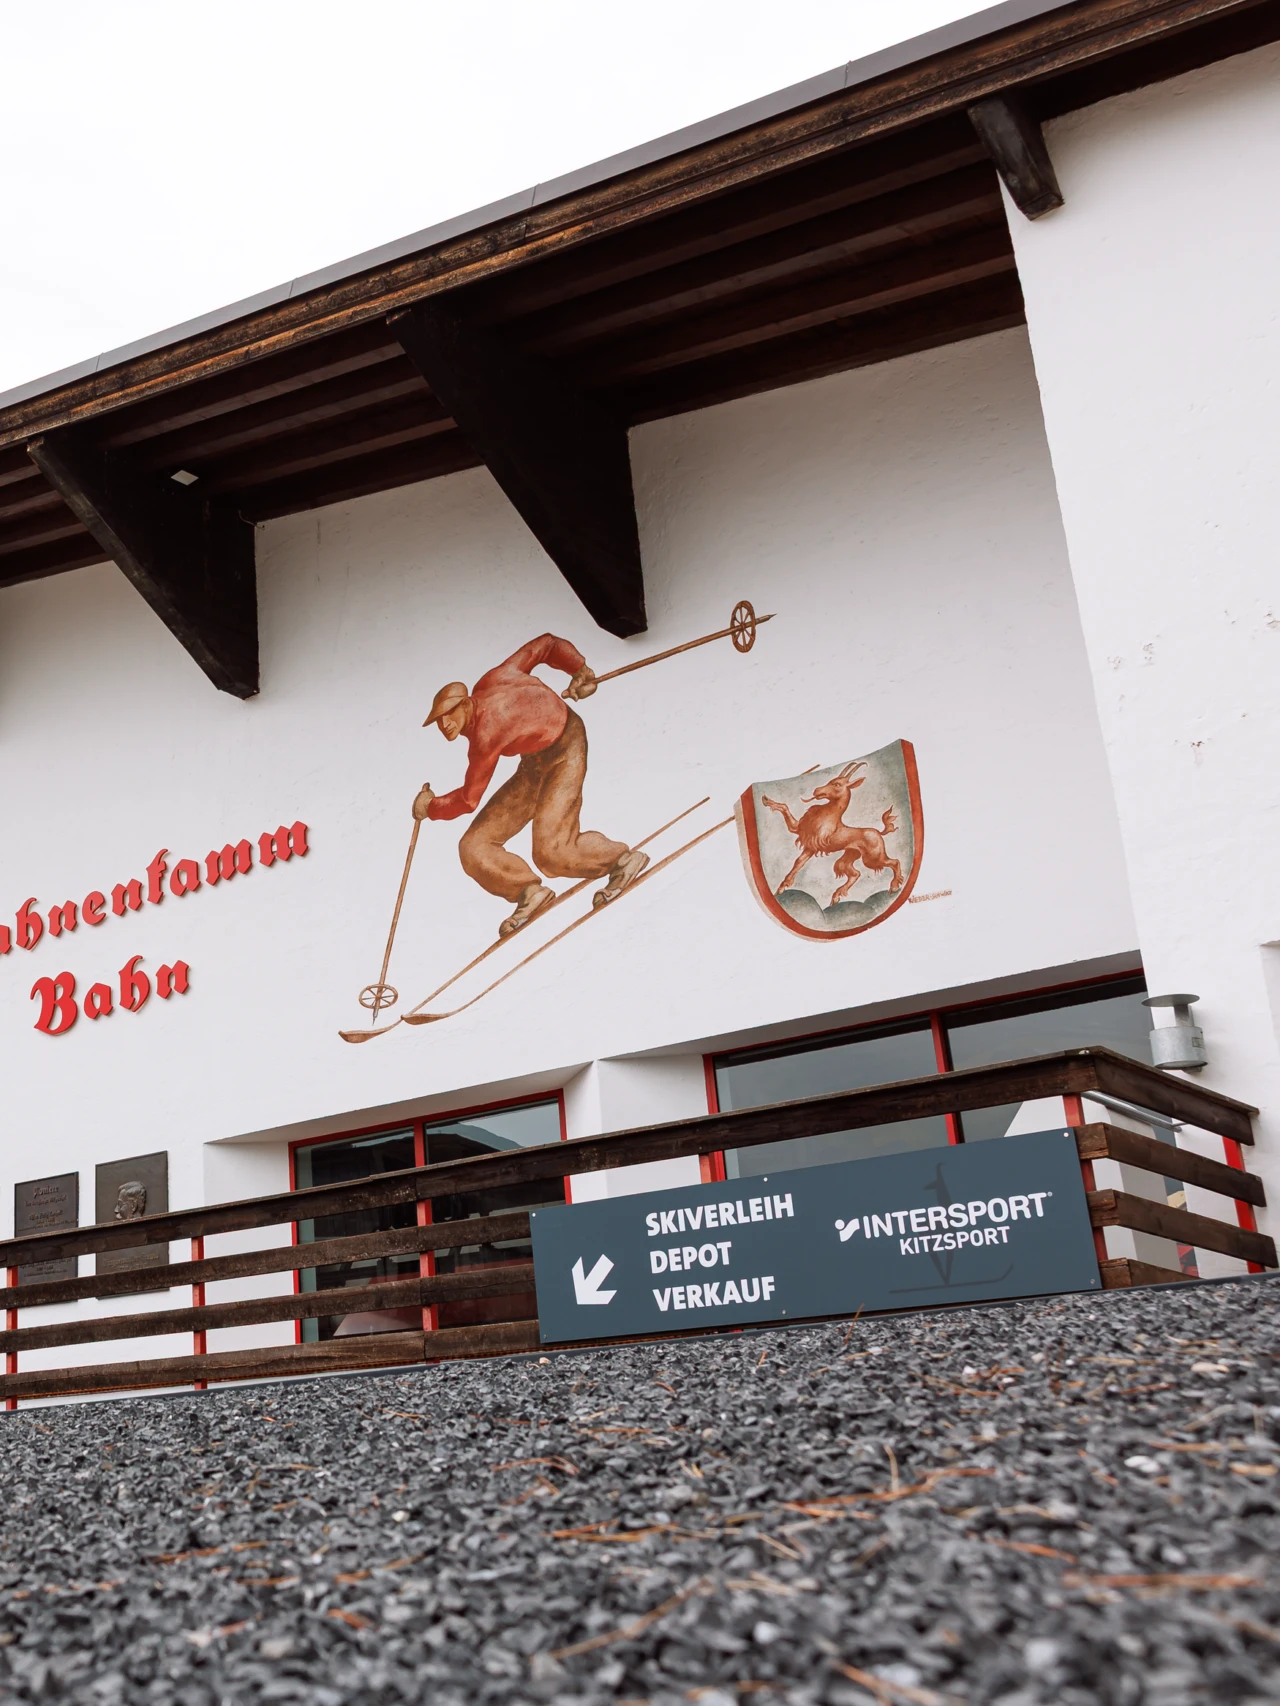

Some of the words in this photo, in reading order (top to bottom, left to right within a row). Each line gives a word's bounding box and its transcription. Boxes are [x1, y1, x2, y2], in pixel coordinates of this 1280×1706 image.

[29, 954, 190, 1036] Bahn
[645, 1193, 795, 1237] SKIVERLEIH
[862, 1192, 1047, 1239] INTERSPORT
[649, 1240, 732, 1274] DEPOT
[899, 1225, 1011, 1256] KITZSPORT
[652, 1275, 776, 1312] VERKAUF
